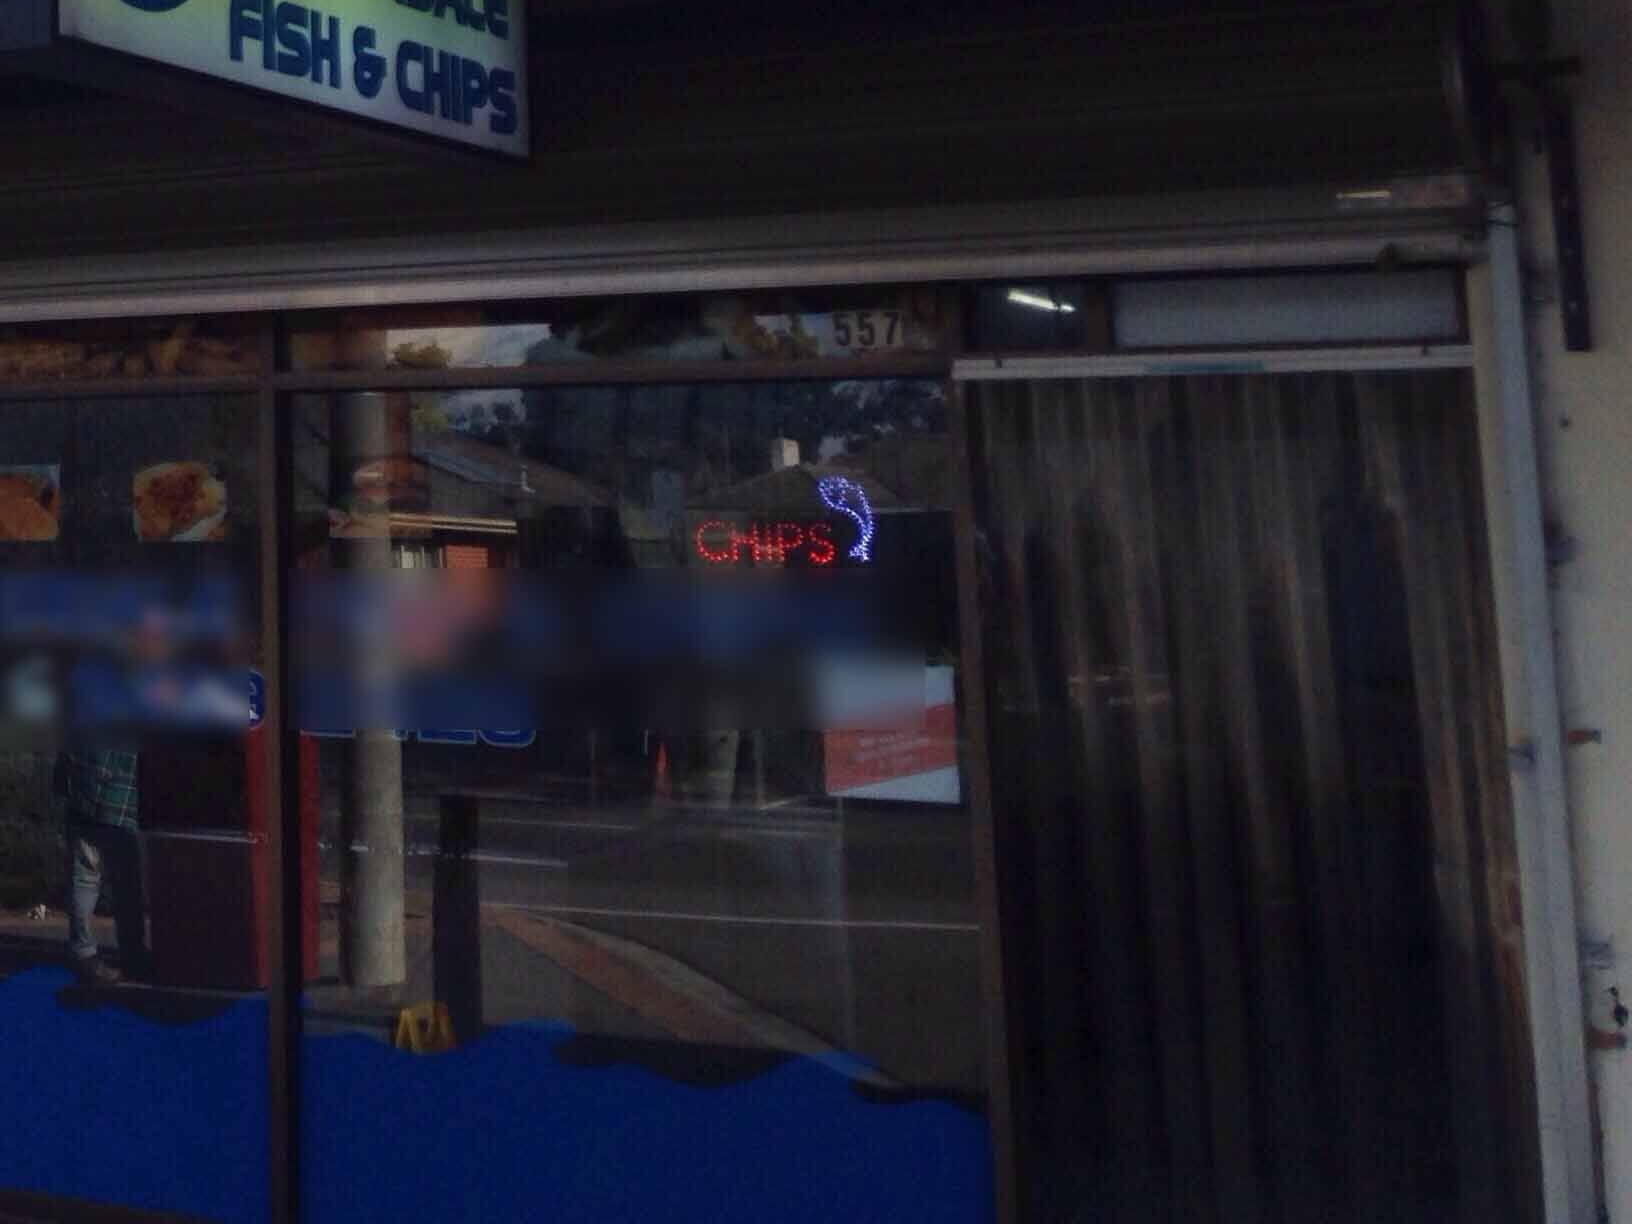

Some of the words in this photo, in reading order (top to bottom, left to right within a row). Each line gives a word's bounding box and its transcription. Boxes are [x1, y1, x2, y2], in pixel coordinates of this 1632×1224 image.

[353, 25, 387, 100] &
[397, 40, 515, 136] CHIPS
[833, 312, 900, 347] 557
[695, 521, 835, 564] CHIPS
